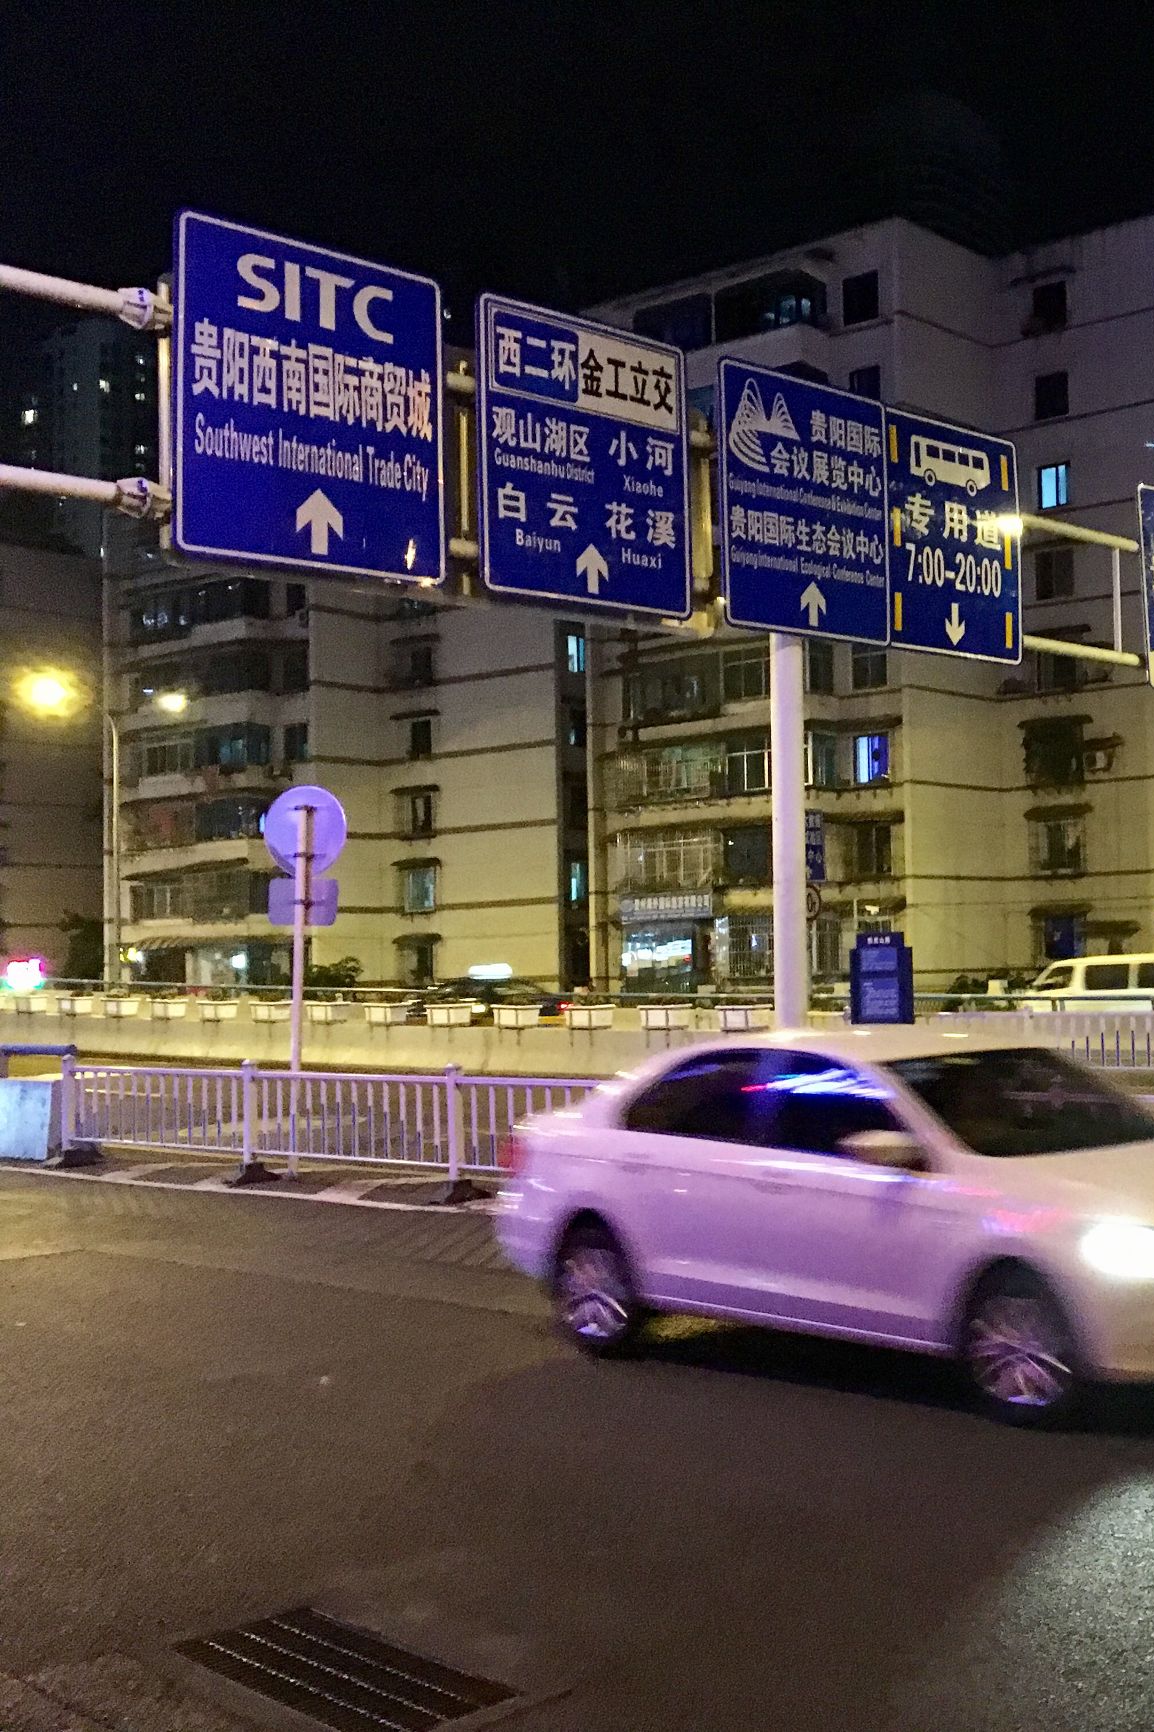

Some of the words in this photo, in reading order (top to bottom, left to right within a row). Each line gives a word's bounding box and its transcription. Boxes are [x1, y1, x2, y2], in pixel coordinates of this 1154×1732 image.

[237, 253, 394, 344] SITC
[191, 317, 433, 442] 贵阳西南国际商贸城
[496, 325, 576, 390] 西二环
[581, 348, 673, 414] 金工立交
[195, 412, 273, 466] Southwest
[279, 428, 364, 485] International
[367, 446, 402, 488] Trade
[403, 453, 429, 501] City
[491, 406, 591, 462] 观山湖区
[608, 430, 675, 477] 小河
[810, 409, 882, 458] 贵阳国际
[494, 448, 566, 480] Guanshanhu
[566, 465, 595, 485] District
[623, 474, 664, 498] Xiaohe
[770, 441, 882, 497] 会议展览中心
[497, 482, 578, 531] 白云
[605, 501, 677, 549] 花溪
[730, 504, 884, 565] 贵阳国际生态会议中心
[904, 492, 1001, 550] 专用道
[515, 528, 561, 554] Baiyun
[621, 547, 662, 570] Huaxi
[905, 542, 1001, 598] 7:00-20:00
